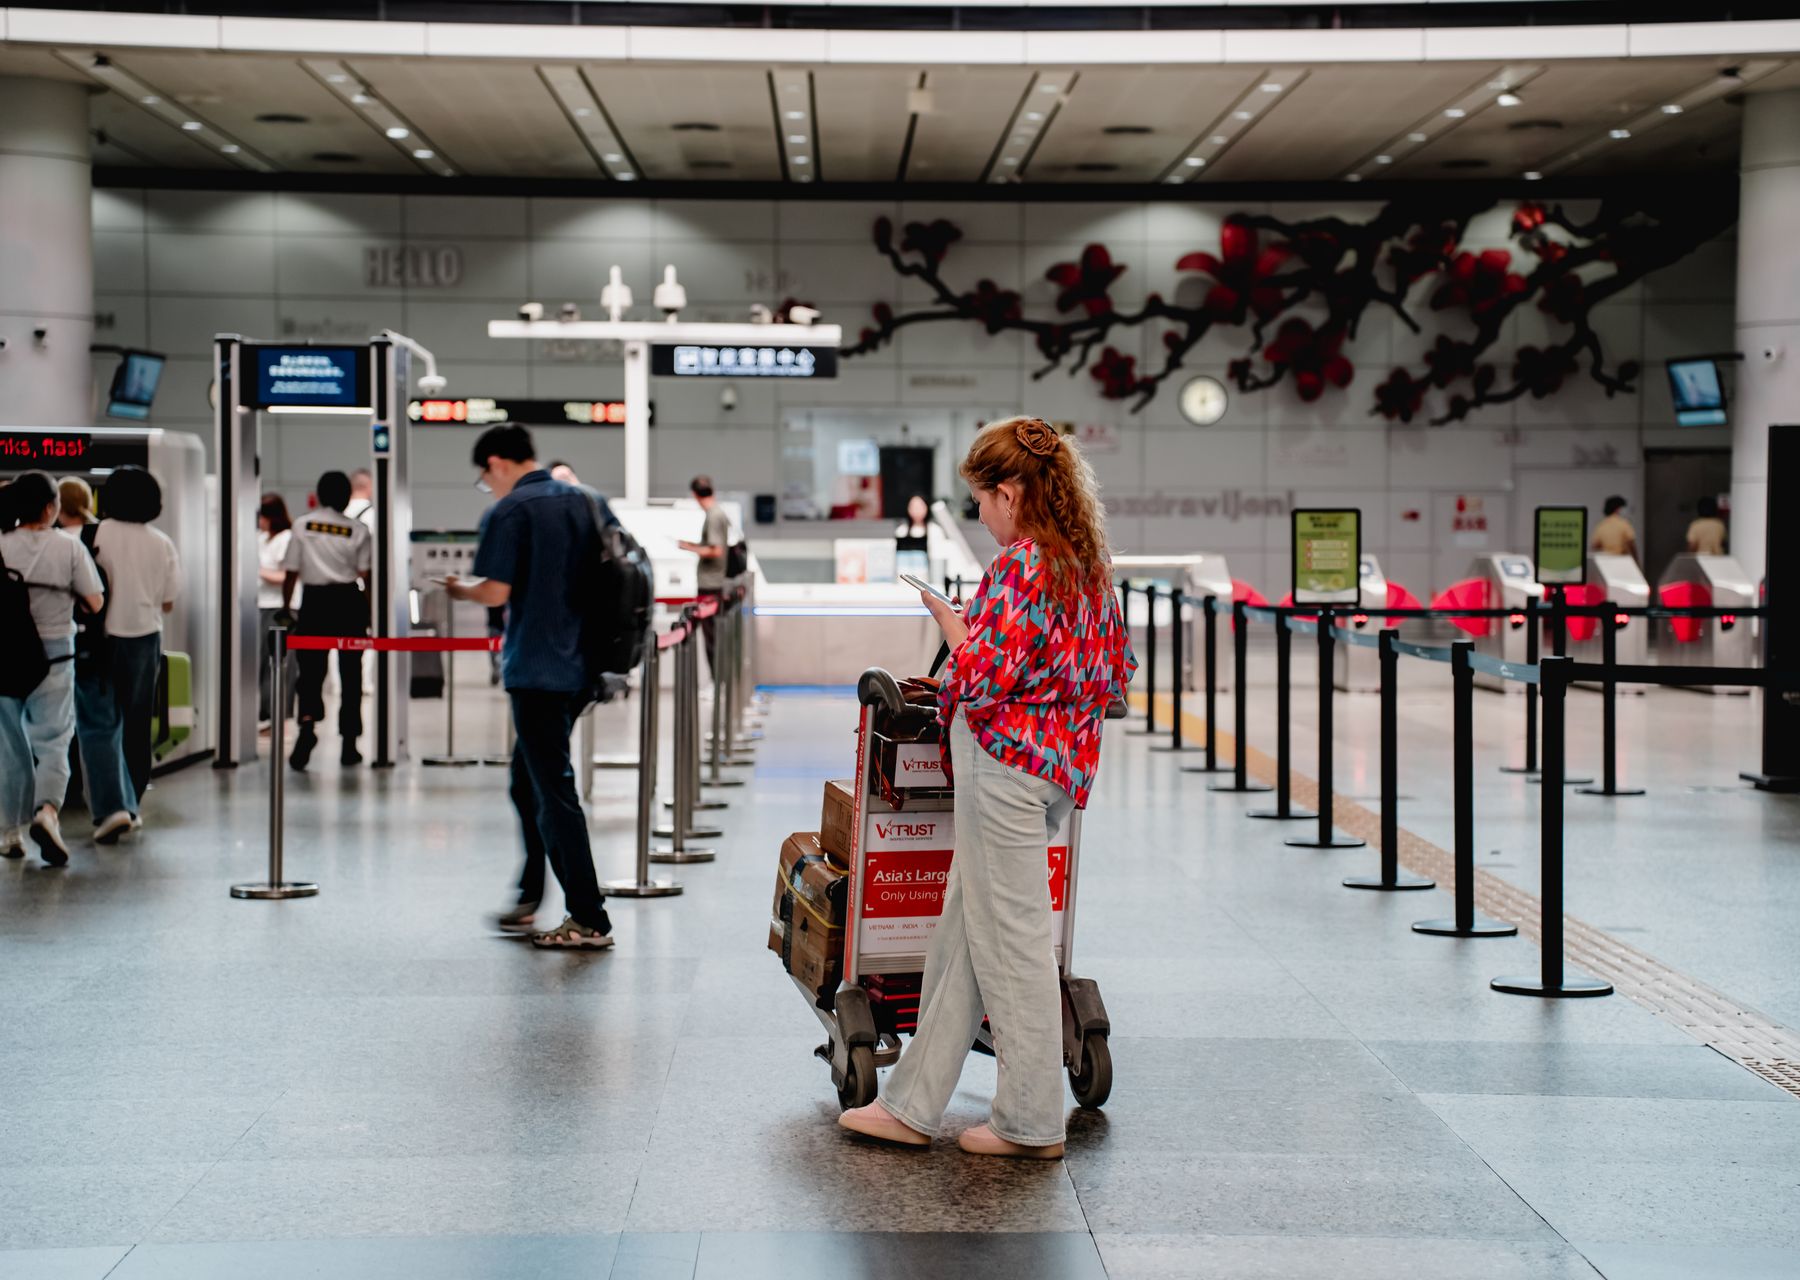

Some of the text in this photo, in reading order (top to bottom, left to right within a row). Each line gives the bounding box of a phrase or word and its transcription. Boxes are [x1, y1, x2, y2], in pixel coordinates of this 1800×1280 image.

[365, 246, 463, 288] HELLO
[873, 869, 912, 882] Asia's
[880, 891, 906, 903] Only
[909, 890, 938, 902] Using
